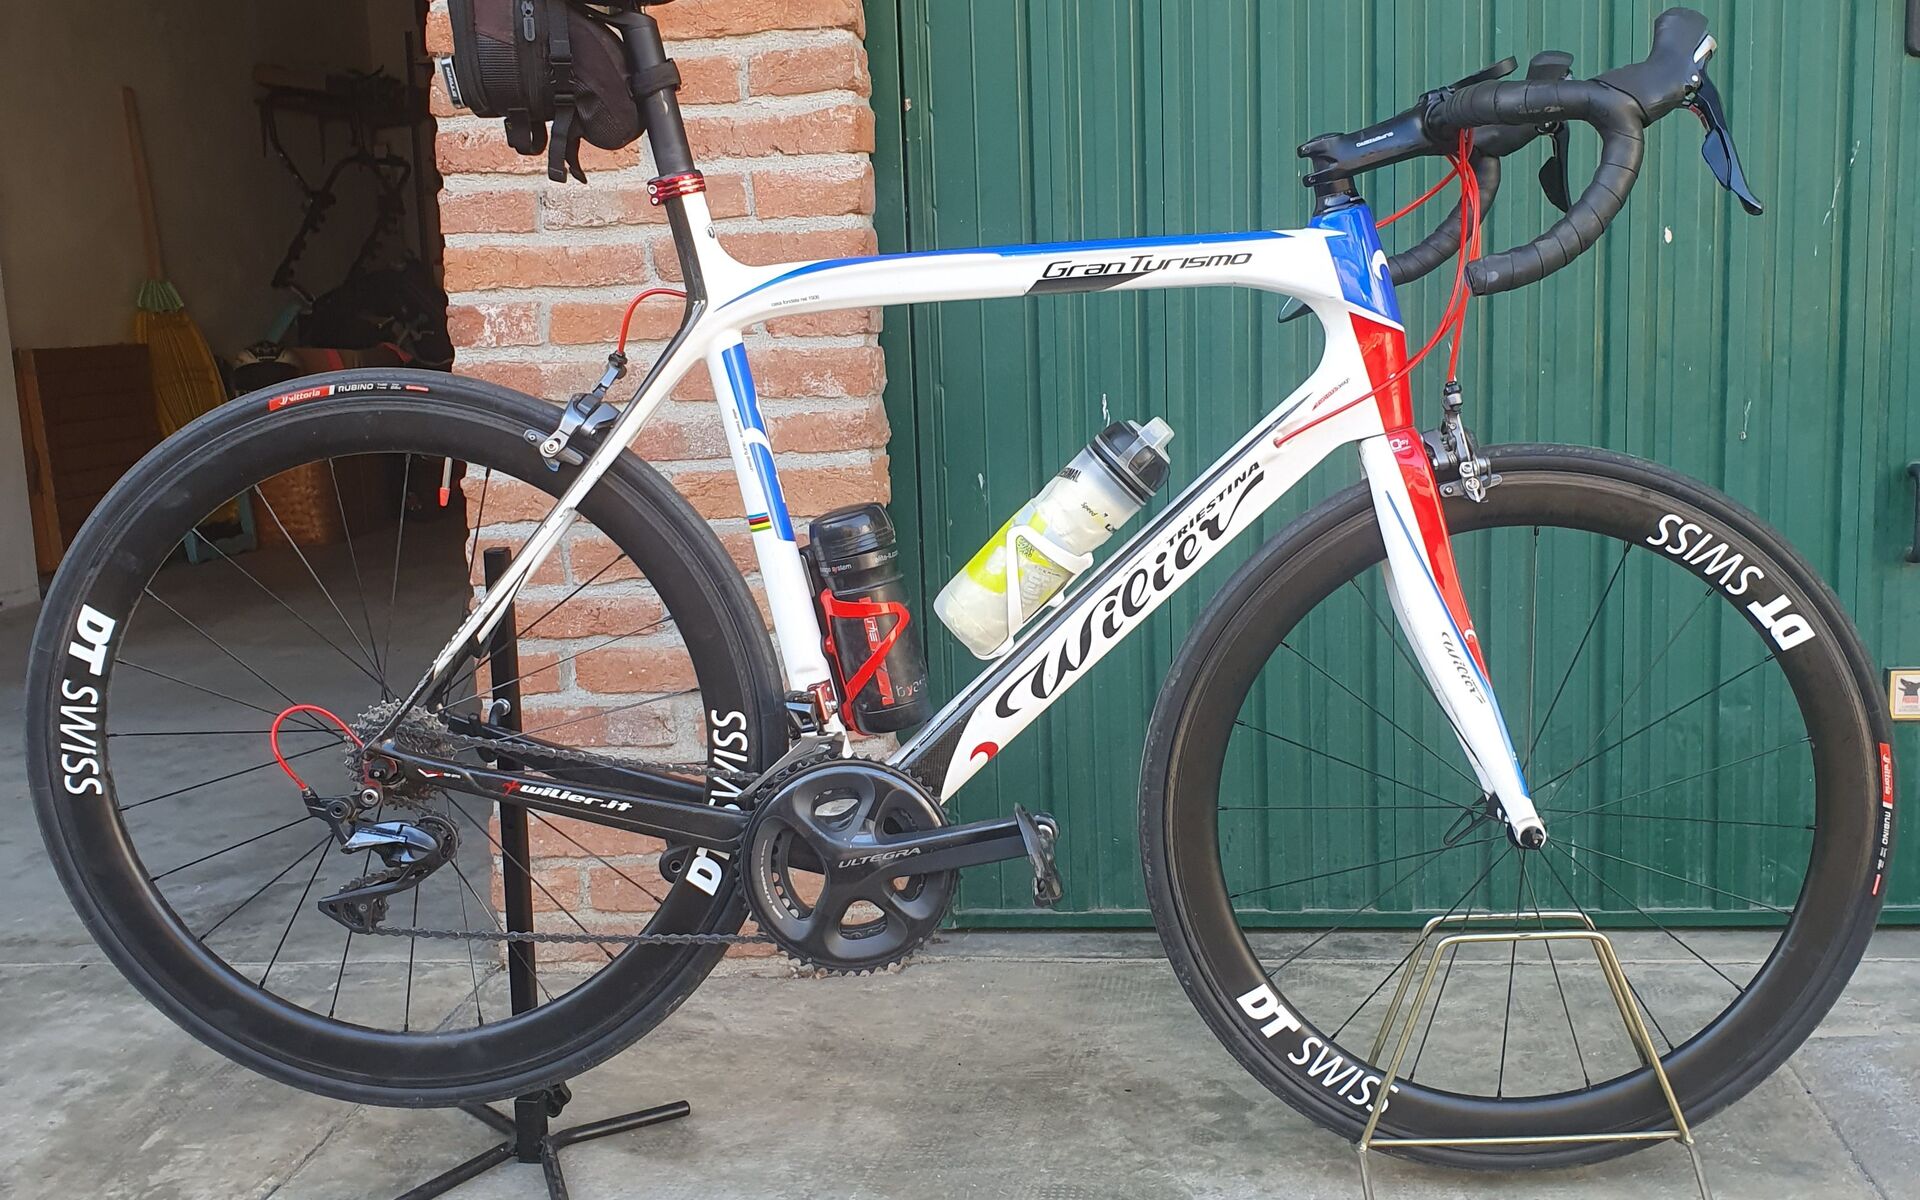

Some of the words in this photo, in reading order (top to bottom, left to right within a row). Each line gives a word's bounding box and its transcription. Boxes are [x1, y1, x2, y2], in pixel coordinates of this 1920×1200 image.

[288, 389, 321, 403] vittoria
[338, 383, 374, 392] RUBINO
[1166, 461, 1260, 548] TRIESTINA
[1646, 514, 1765, 596] SWISS
[995, 470, 1265, 719] Wilier
[1746, 593, 1816, 651] DT
[68, 603, 116, 676] DT
[59, 678, 103, 795] SWISS
[838, 847, 922, 869] ULTEGRA
[1881, 811, 1891, 845] RUBINO
[1236, 983, 1302, 1039] DT
[1287, 1036, 1399, 1113] SWISS
